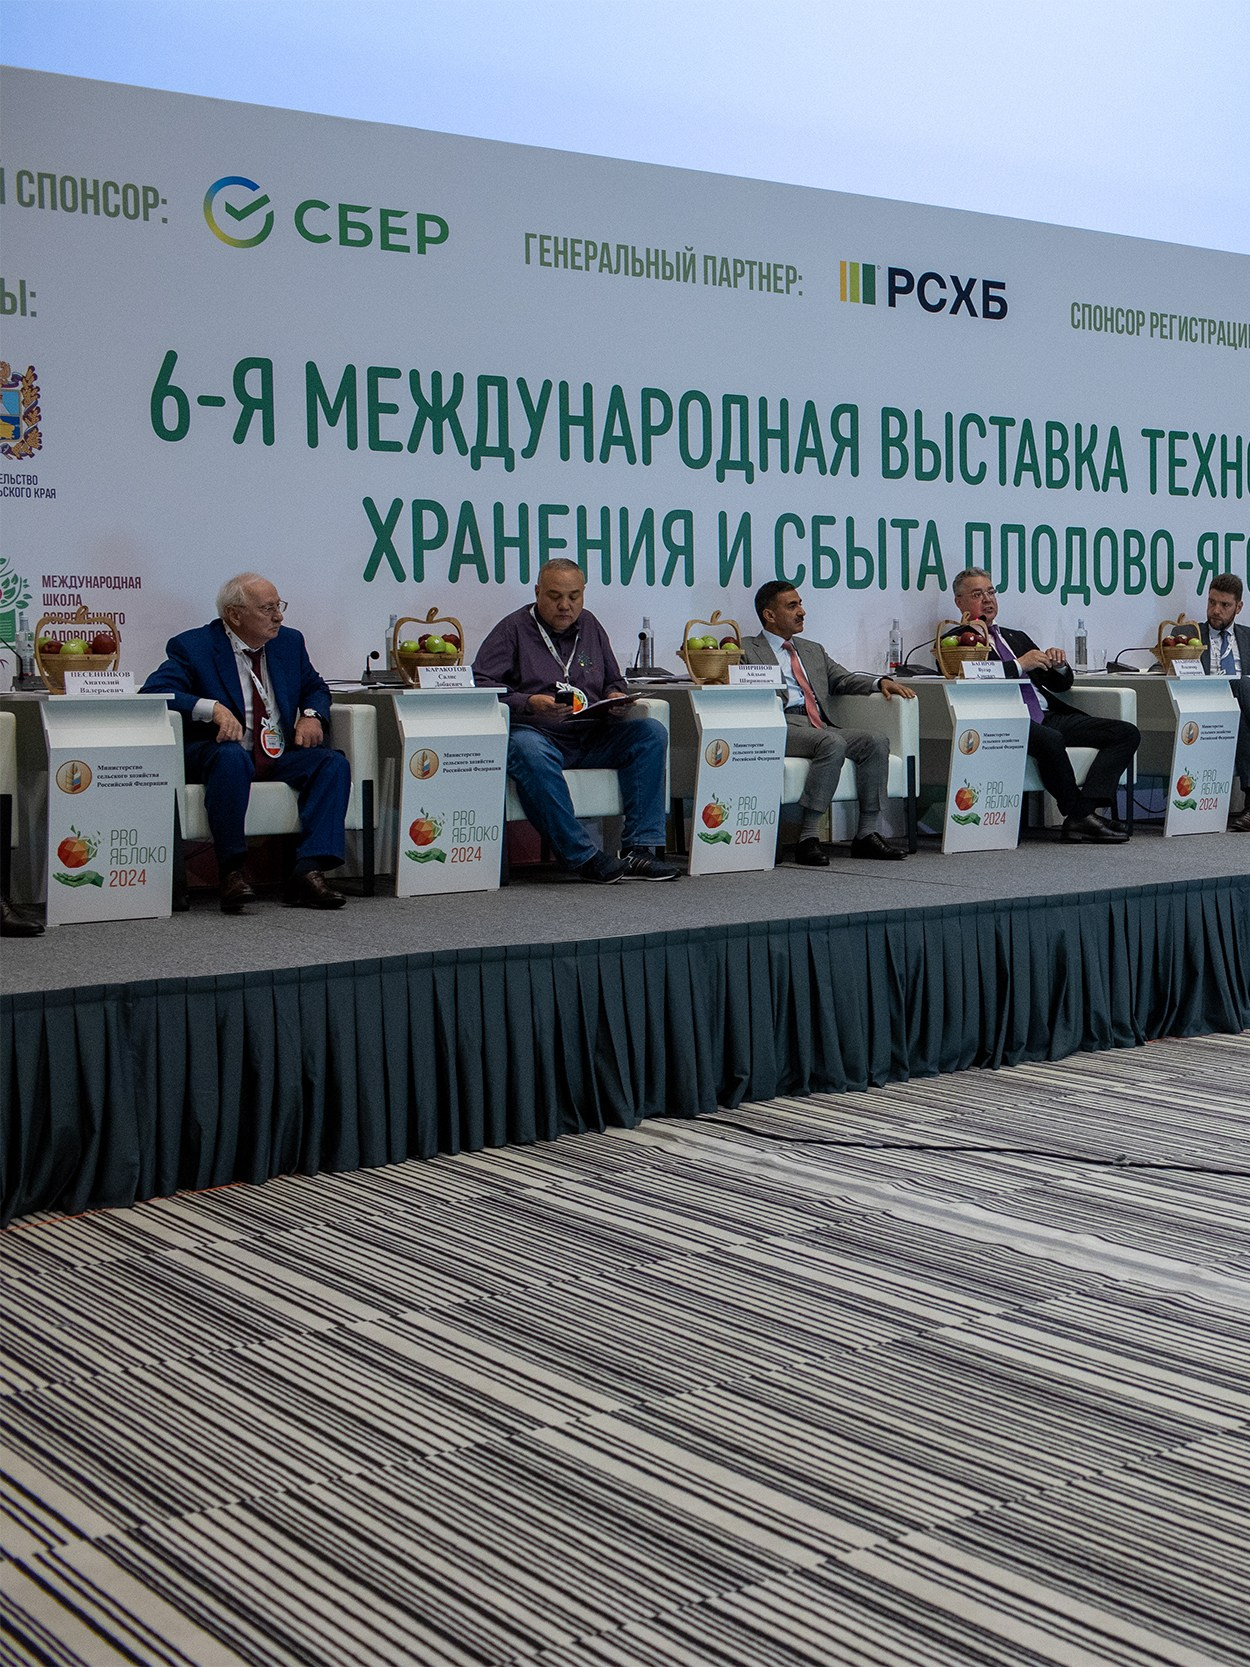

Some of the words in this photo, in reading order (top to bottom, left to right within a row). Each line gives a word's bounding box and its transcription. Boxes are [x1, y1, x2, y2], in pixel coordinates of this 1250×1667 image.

[16, 169, 169, 224] СПОНСОР:
[293, 198, 450, 256] СБЕР
[524, 232, 697, 285] ГЕНЕРАЛЬНЫЙ
[703, 254, 803, 297] ПАРТНЕР:
[887, 266, 1008, 321] РСХБ
[1070, 301, 1146, 338] СПОНСОР
[150, 349, 275, 447] 6-Я
[305, 360, 860, 486] МЕЖДУНАРОДНАЯ
[880, 406, 1129, 494] ВЫСТАВКА
[33, 487, 57, 499] КРАЯ
[362, 496, 696, 589] ХРАНЕНИЯ
[718, 510, 769, 590] И
[773, 512, 948, 593] СБЫТА
[42, 575, 142, 590] МЕЖДУНАРОДНАЯ
[42, 593, 83, 606] ШКОЛА
[1202, 769, 1217, 782] PRO
[986, 781, 1004, 795] PRO
[737, 796, 758, 811] PRO
[984, 794, 1020, 809] ЯБЛОКО
[1199, 797, 1218, 811] 2024
[452, 809, 476, 827] PRO
[736, 810, 776, 827] ЯБЛОКО
[983, 811, 1006, 826] 2024
[110, 828, 138, 847] PRO
[451, 825, 499, 844] ЯБЛОКО
[734, 829, 761, 845] 2024
[109, 846, 167, 866] ЯБЛОКО
[450, 846, 482, 863] 2024
[109, 868, 147, 888] 2024
